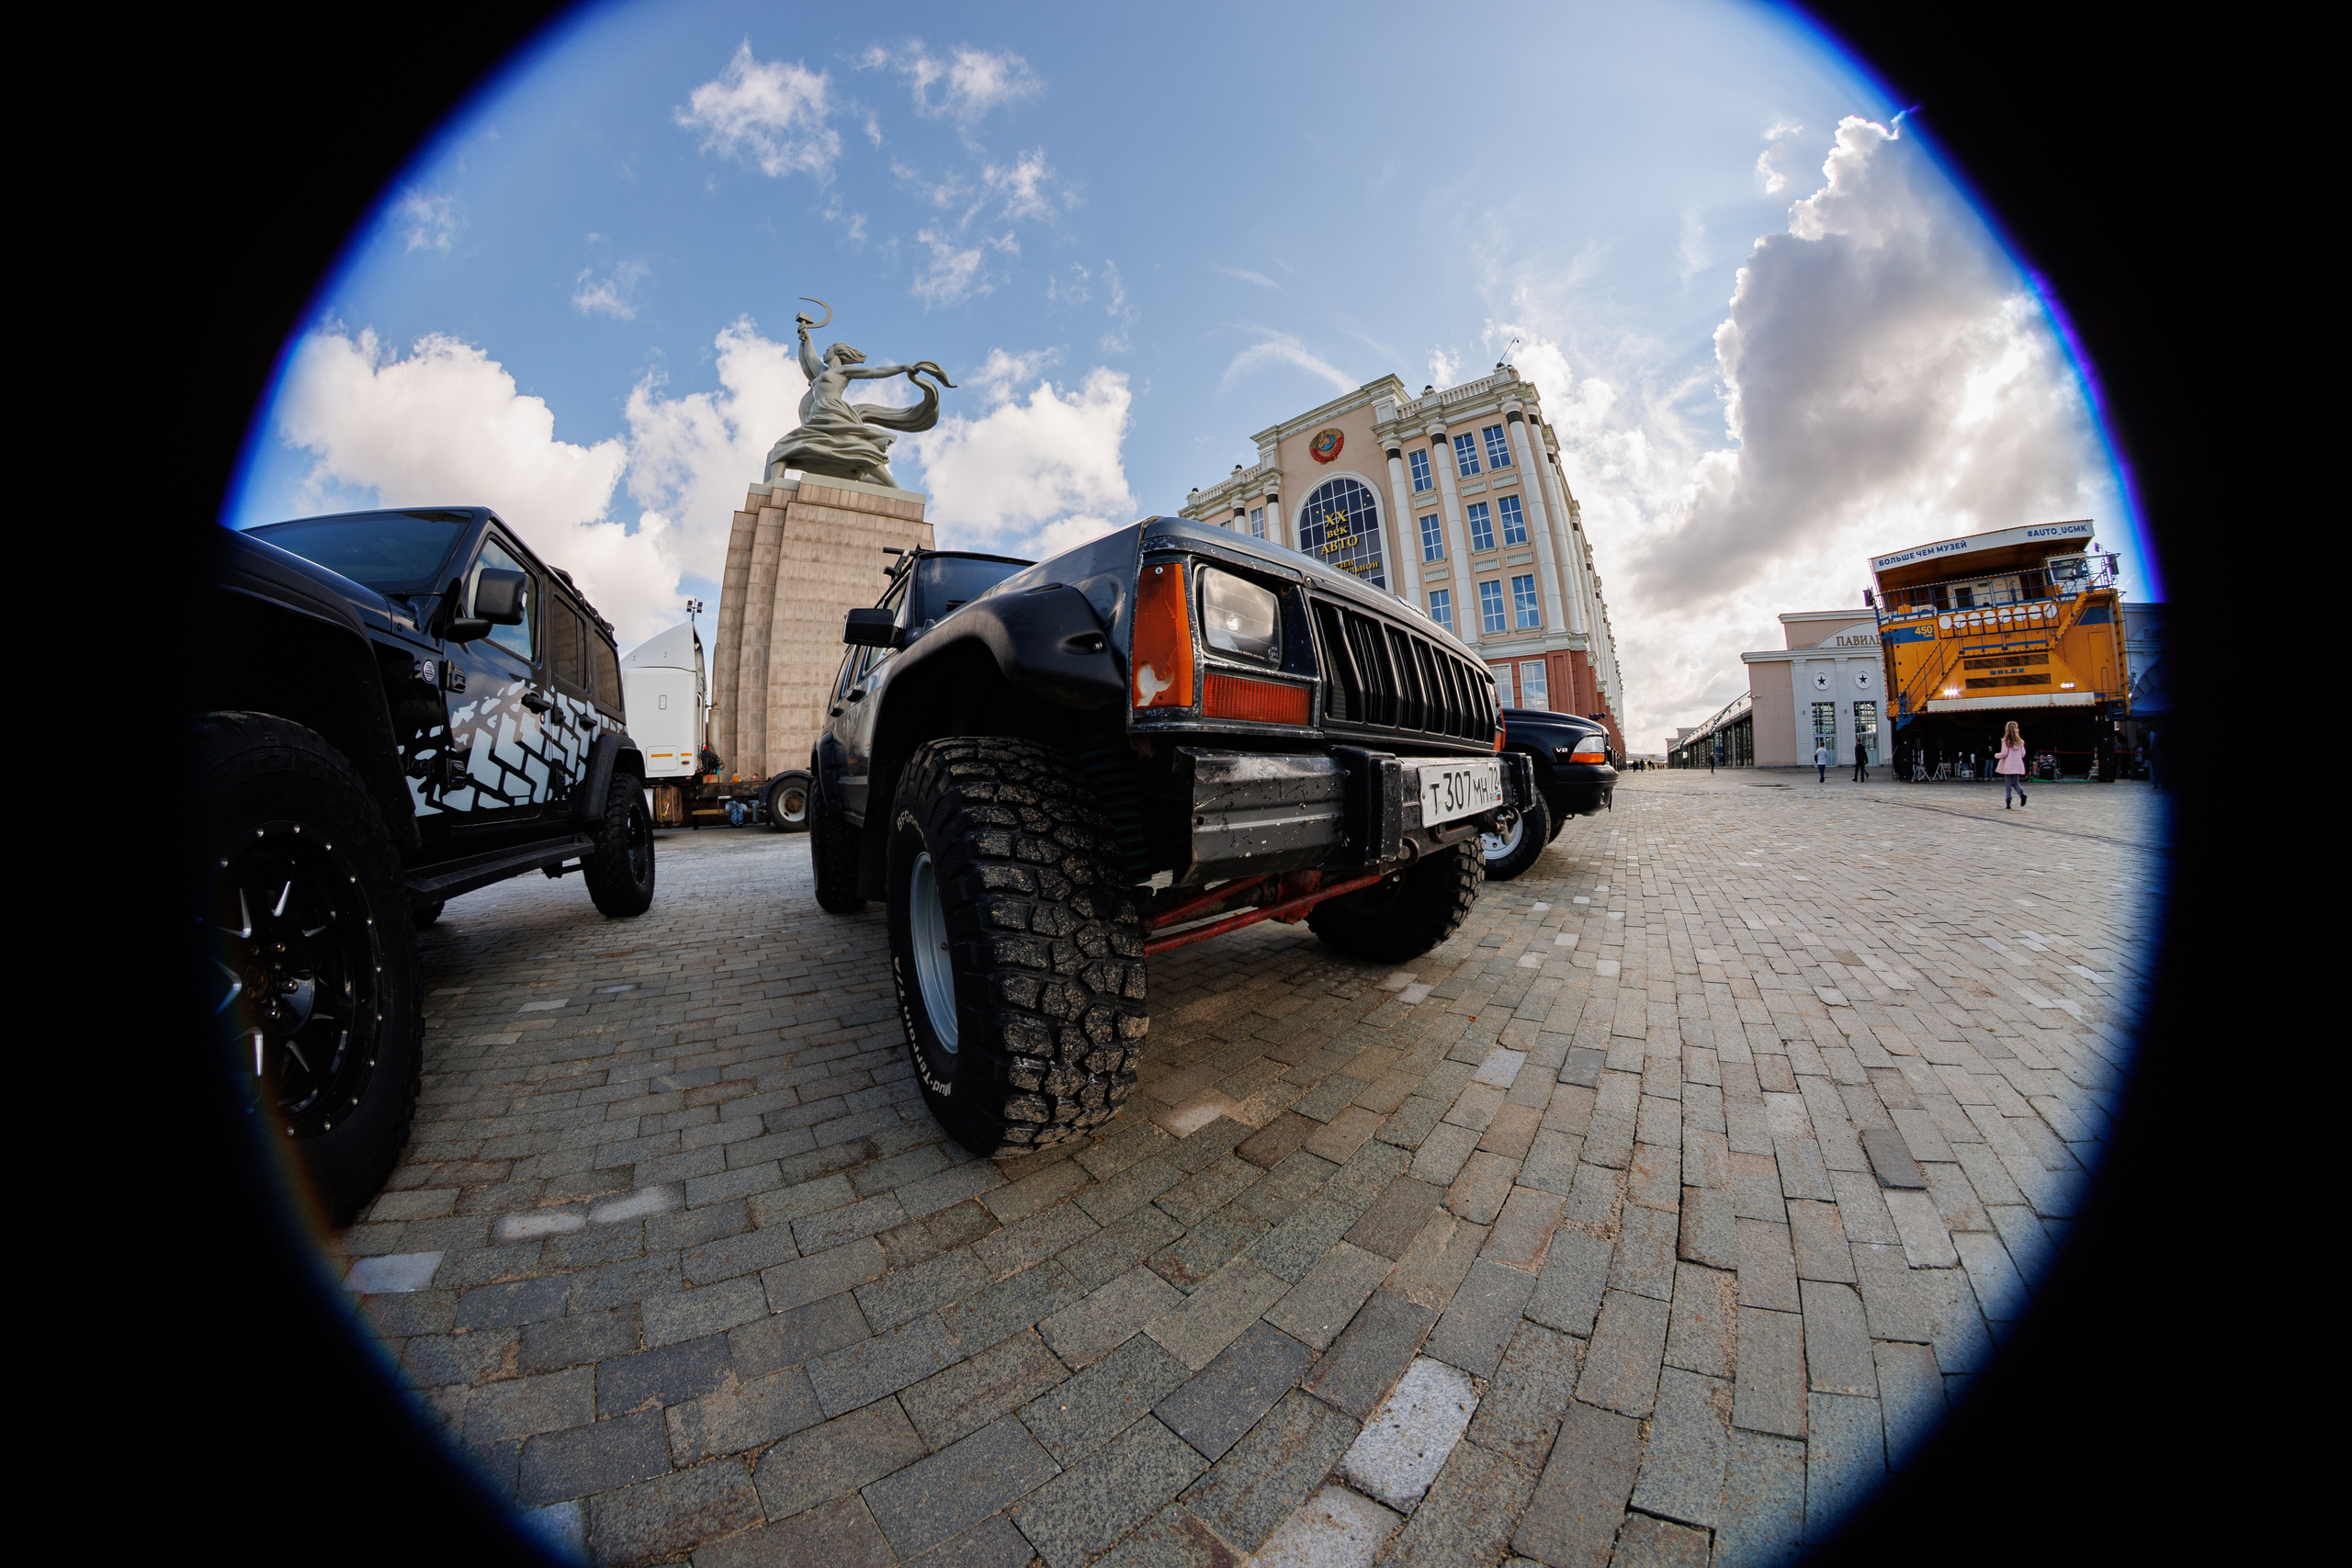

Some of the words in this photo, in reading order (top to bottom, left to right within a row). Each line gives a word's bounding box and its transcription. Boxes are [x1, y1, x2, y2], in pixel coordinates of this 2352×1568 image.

[1327, 525, 1348, 538] век
[2027, 525, 2087, 537] #AUTO_UGMK
[1320, 536, 1358, 555] АВТО
[1879, 553, 1915, 566] БОЛЬШЕ
[1917, 547, 1935, 558] ЧЕМ
[1936, 540, 1967, 553] МУЗЕЙ
[1915, 626, 1933, 635] 450
